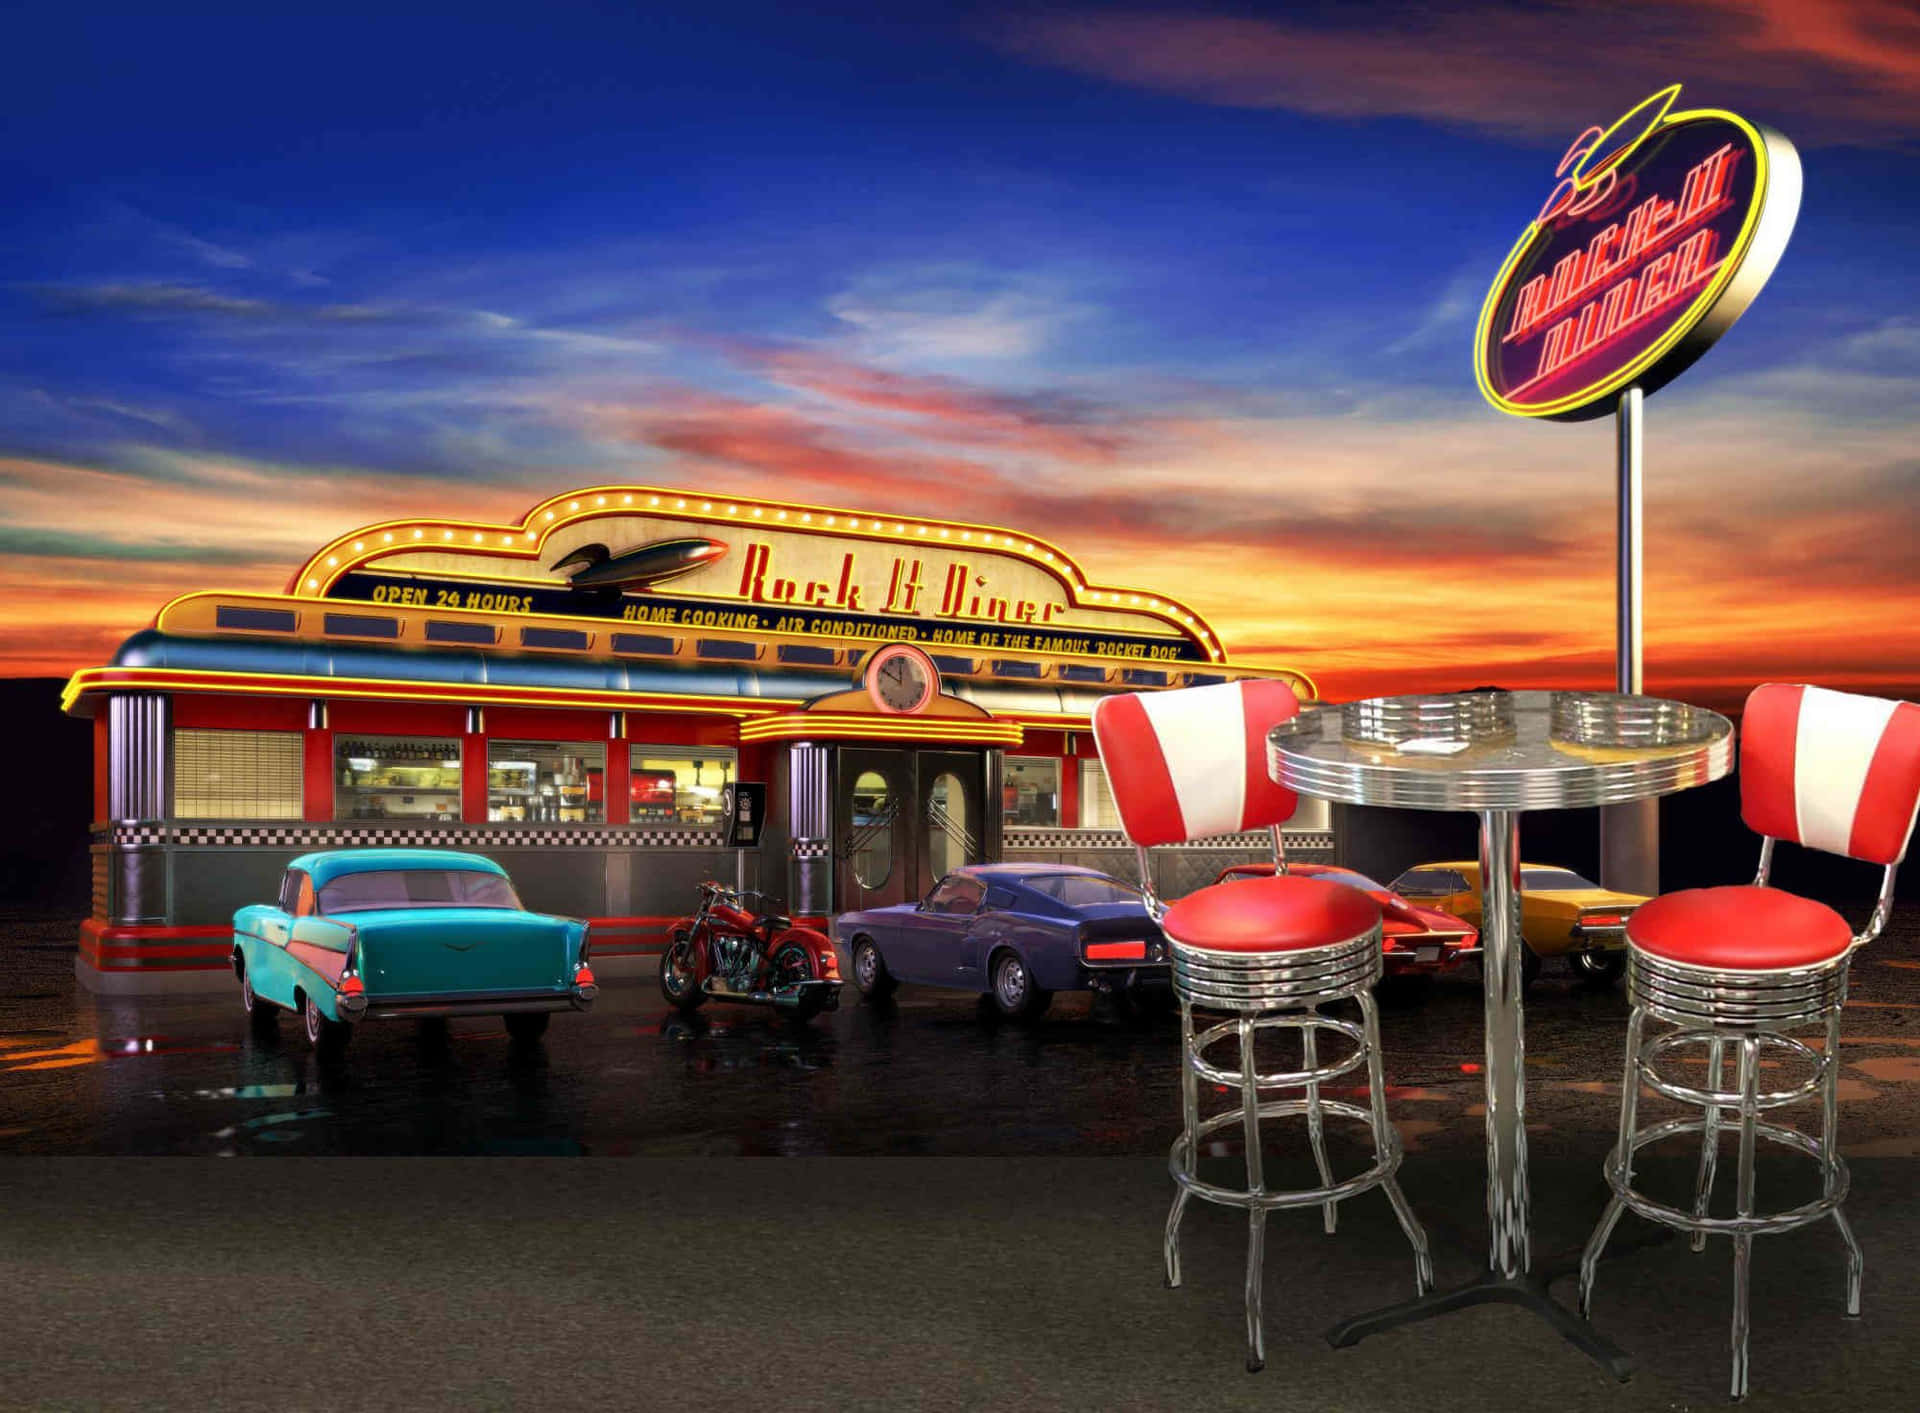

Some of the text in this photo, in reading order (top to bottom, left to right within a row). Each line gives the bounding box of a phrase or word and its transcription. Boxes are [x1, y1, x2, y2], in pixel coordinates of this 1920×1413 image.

[1537, 228, 1712, 378] DINER
[373, 585, 533, 613] OPEN 24 HOURS
[739, 543, 1065, 624] Rock It Diner
[623, 604, 676, 624] HOME
[681, 611, 758, 629] COOKING
[776, 615, 804, 633] AIR
[811, 618, 918, 641] CONDITIONED
[932, 629, 976, 645] HOME
[980, 632, 999, 647] OF
[1003, 634, 1029, 649] THE
[1034, 636, 1090, 654] FAMOUS
